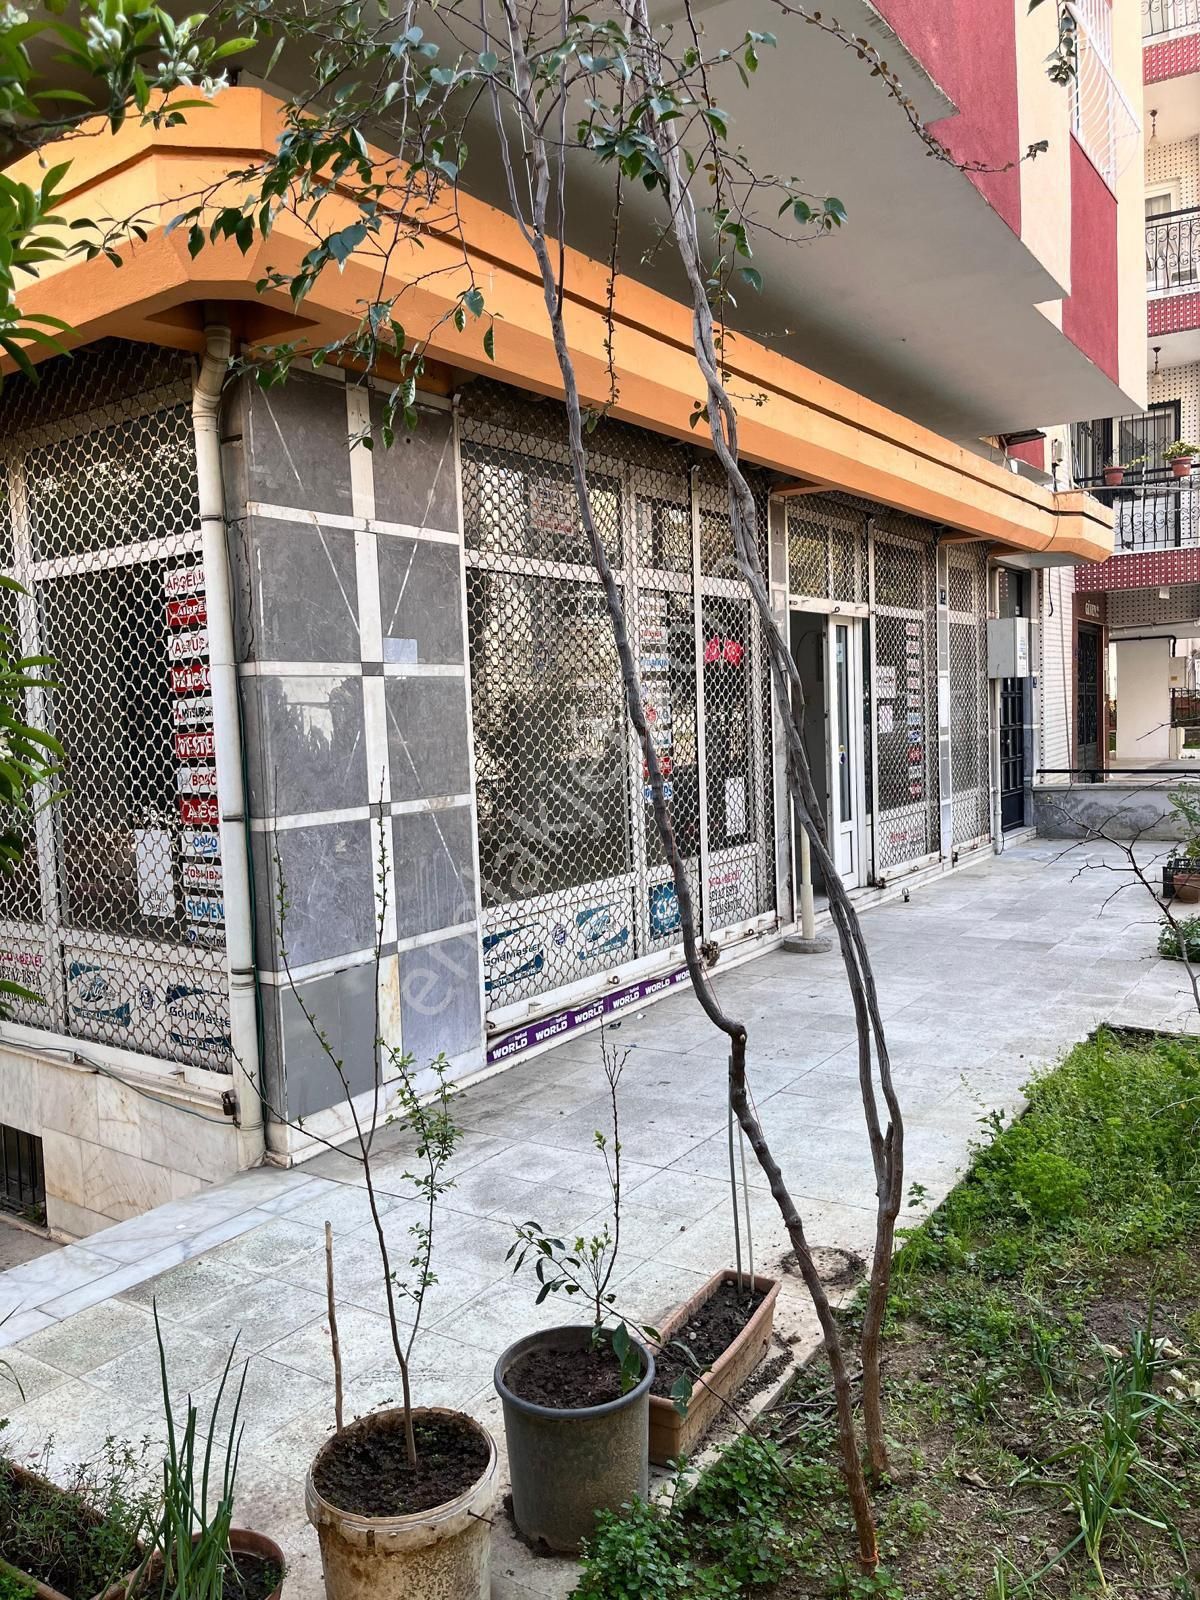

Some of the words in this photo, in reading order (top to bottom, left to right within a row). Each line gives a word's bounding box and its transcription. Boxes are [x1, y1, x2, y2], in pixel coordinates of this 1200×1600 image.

[179, 605, 207, 616] AIRFE
[182, 706, 213, 719] MITSUBISH
[178, 736, 214, 755] VESTE
[192, 774, 217, 786] BOSC
[187, 805, 218, 819] AEG
[187, 899, 224, 919] SIEMEN
[169, 1006, 230, 1028] GoldMate
[492, 1038, 528, 1060] WORLD
[535, 1021, 568, 1041] WORLD
[574, 1005, 604, 1024] WORLD
[612, 992, 640, 1009] WORLD
[644, 978, 671, 995] WORLD
[675, 969, 691, 982] WOR
